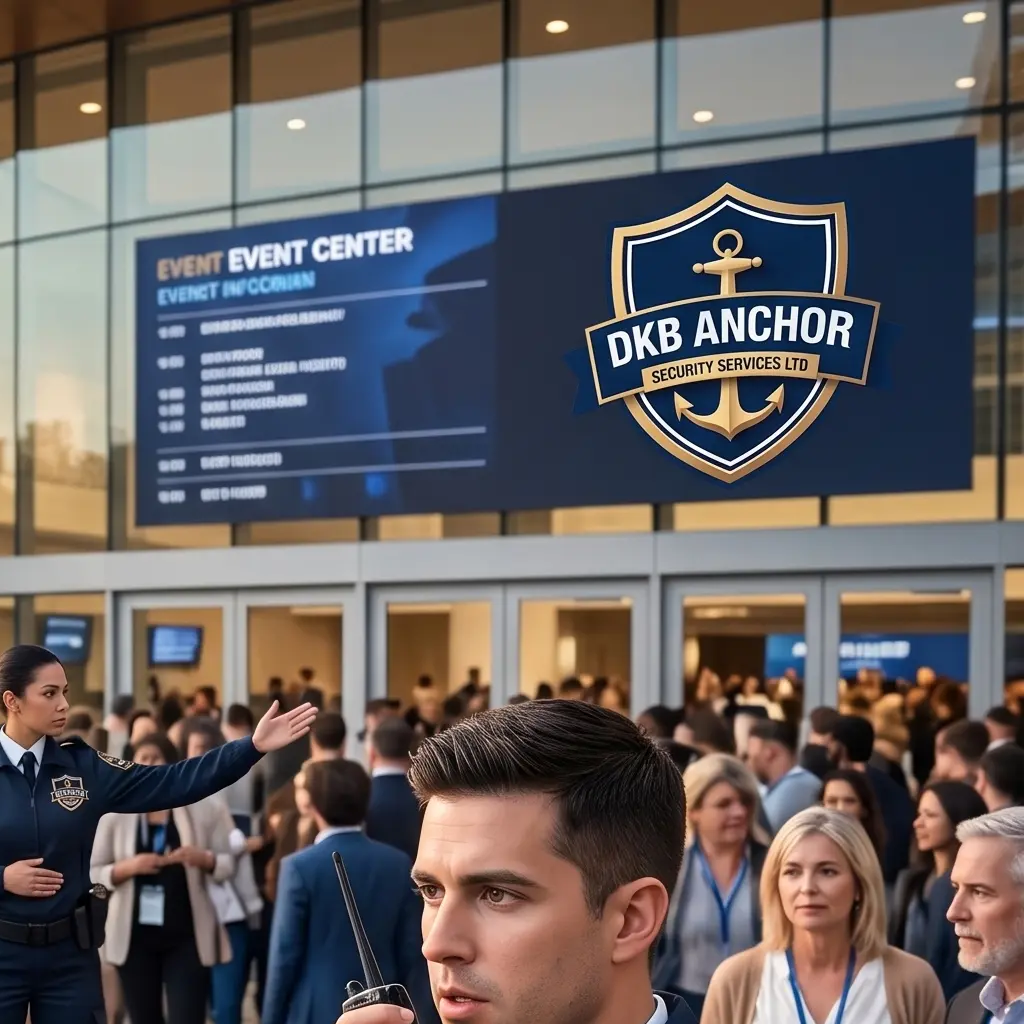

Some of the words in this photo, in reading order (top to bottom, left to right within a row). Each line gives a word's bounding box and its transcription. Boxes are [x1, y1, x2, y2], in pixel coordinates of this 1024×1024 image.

[157, 252, 224, 281] EVENT
[228, 239, 308, 273] EVENT
[311, 226, 414, 263] CENTER
[606, 316, 683, 369] DKB
[693, 305, 854, 349] ANCHOR
[651, 360, 714, 384] SECURITY
[718, 356, 782, 373] SERVICES
[785, 357, 808, 372] LTD
